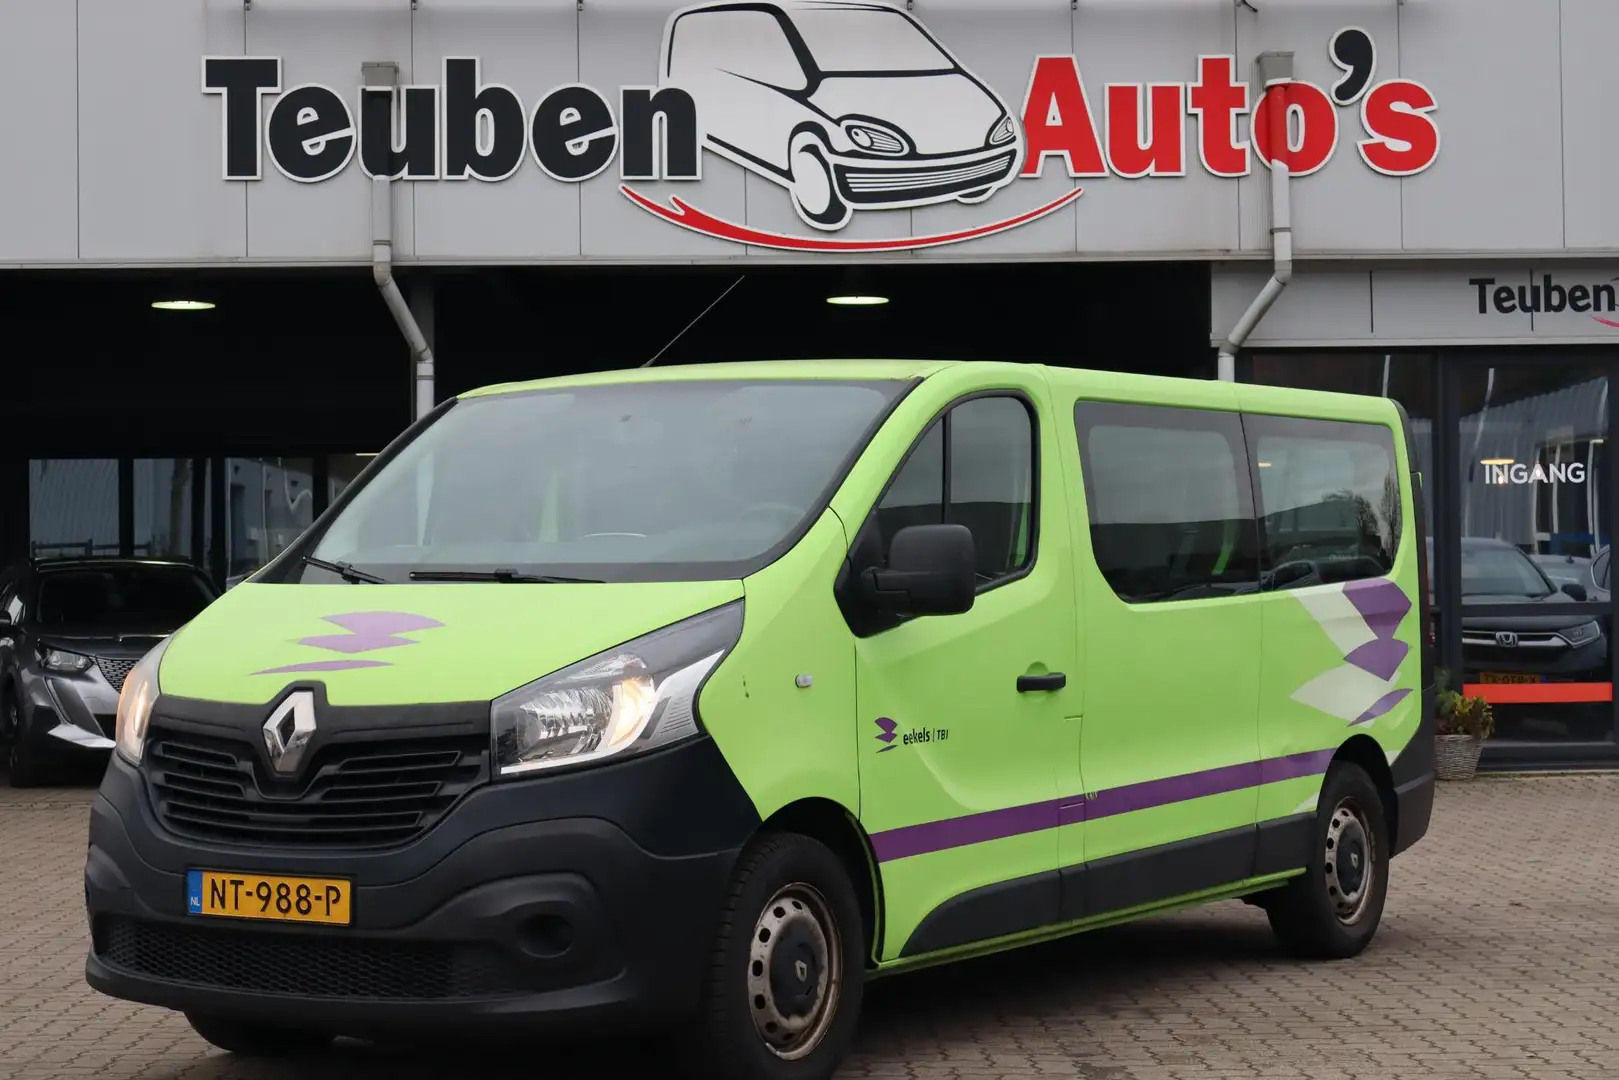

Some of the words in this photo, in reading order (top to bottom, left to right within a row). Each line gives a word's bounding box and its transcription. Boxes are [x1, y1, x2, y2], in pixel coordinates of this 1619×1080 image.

[203, 57, 700, 181] Teuben
[1021, 27, 1440, 176] Auto's
[1469, 273, 1616, 314] Teuben
[1485, 462, 1585, 484] INGANG
[903, 727, 930, 745] eekels
[190, 896, 200, 906] NL
[210, 878, 341, 916] NT-988-P
